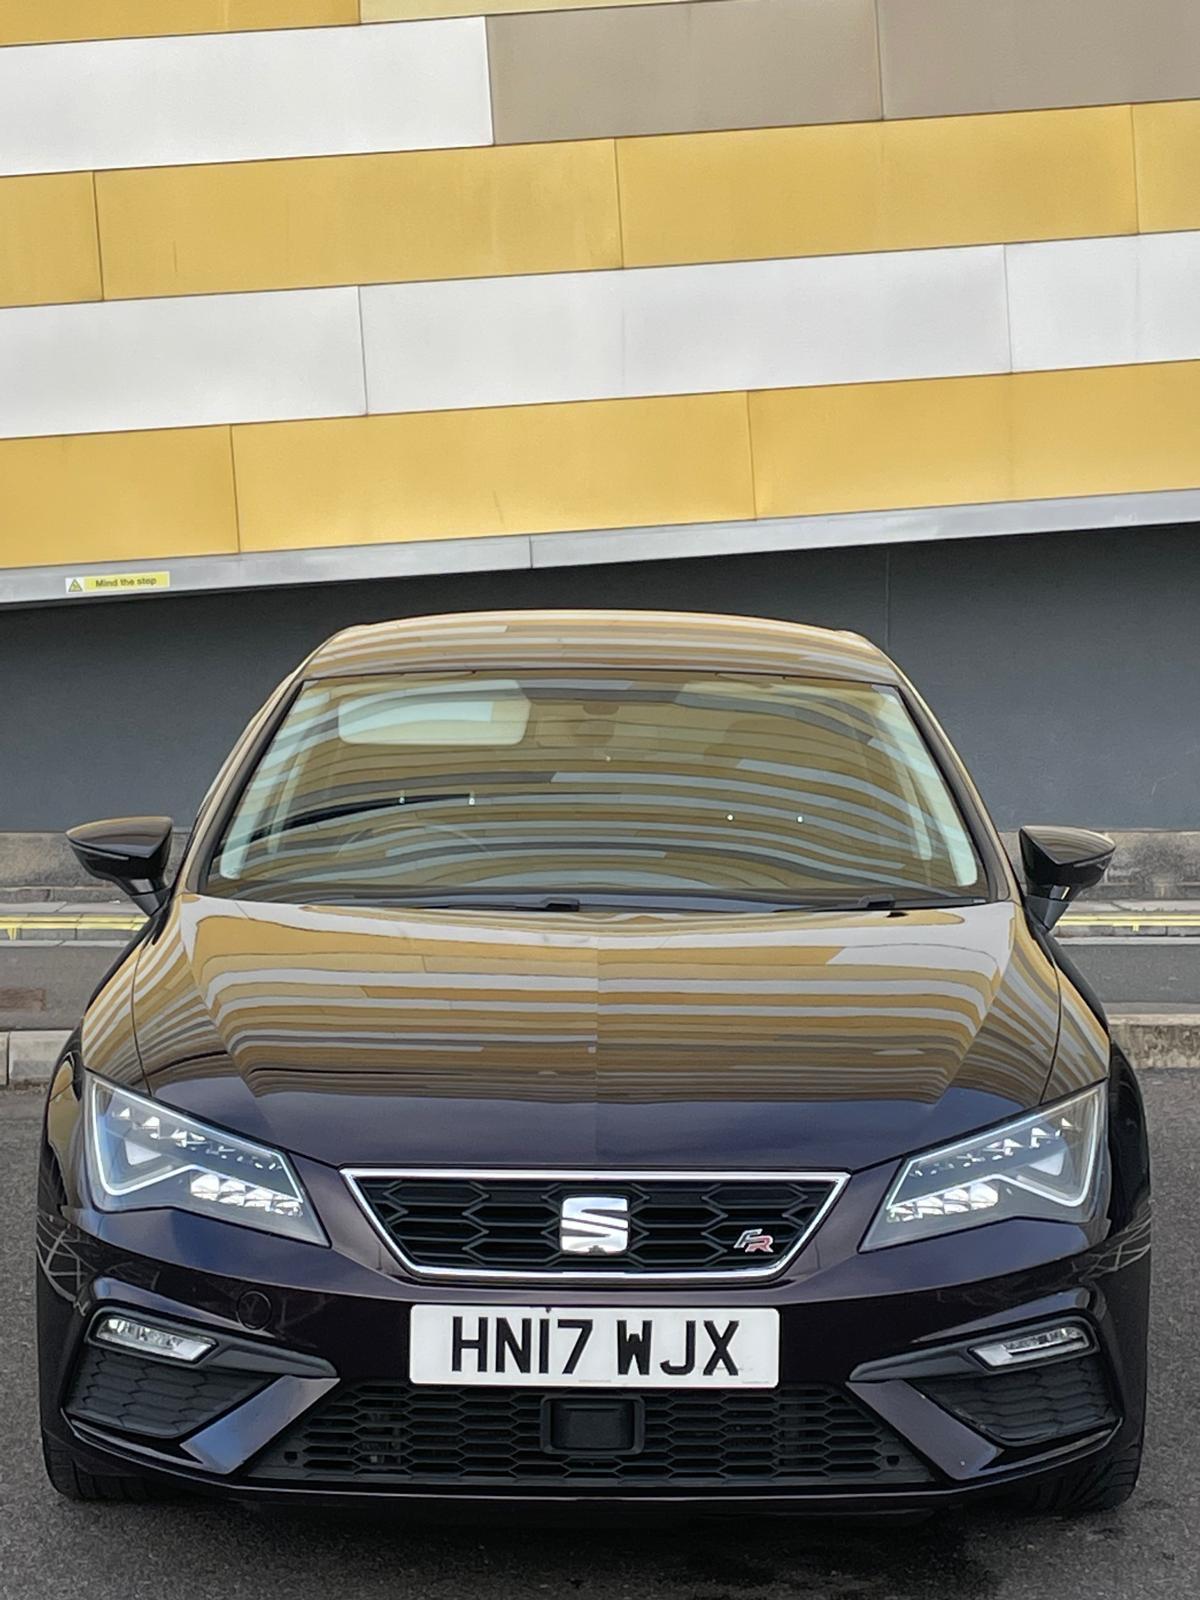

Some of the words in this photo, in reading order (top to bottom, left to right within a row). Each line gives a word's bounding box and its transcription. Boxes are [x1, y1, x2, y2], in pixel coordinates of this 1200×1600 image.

[95, 578, 119, 588] Mind
[120, 578, 135, 587] the
[733, 1228, 774, 1253] FR
[451, 1315, 594, 1375] HN17
[616, 1319, 740, 1377] WJX
